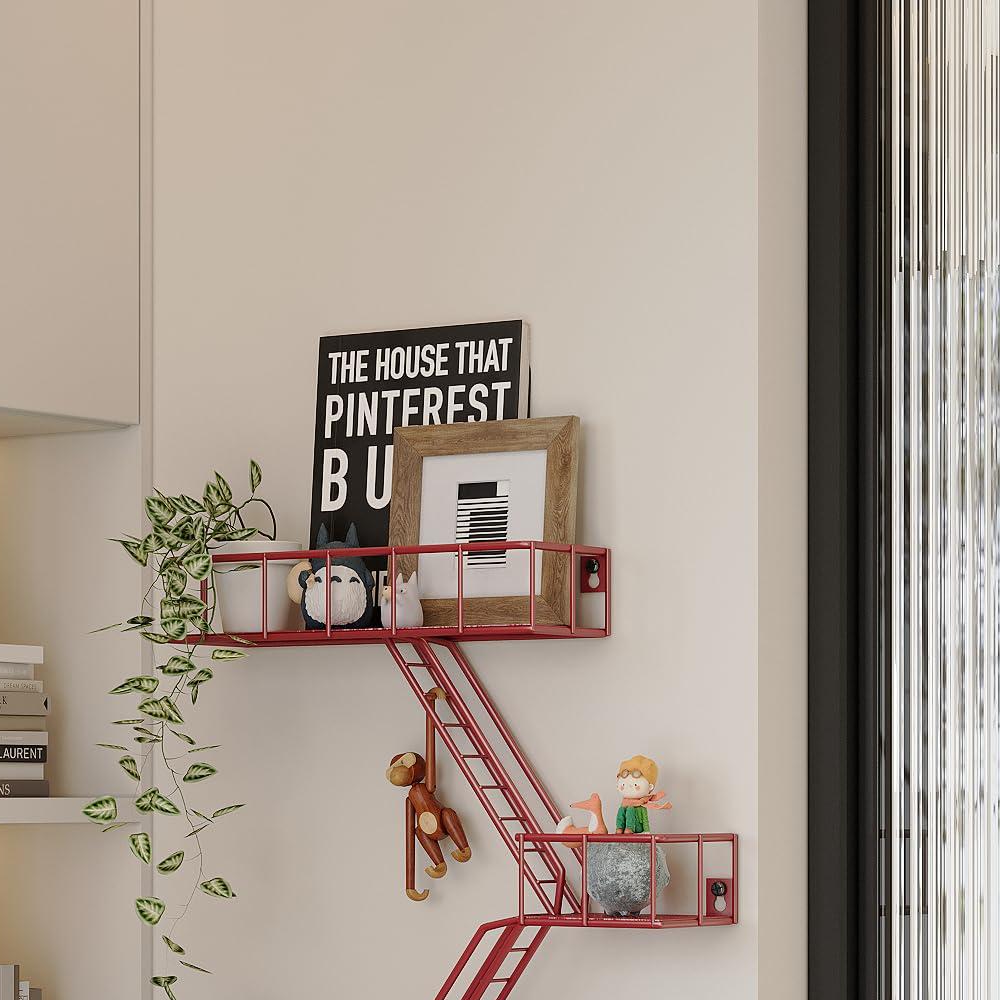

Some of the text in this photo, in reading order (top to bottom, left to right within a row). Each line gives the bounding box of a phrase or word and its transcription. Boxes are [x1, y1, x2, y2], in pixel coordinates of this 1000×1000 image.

[328, 337, 513, 385] THE HOUSE THAT
